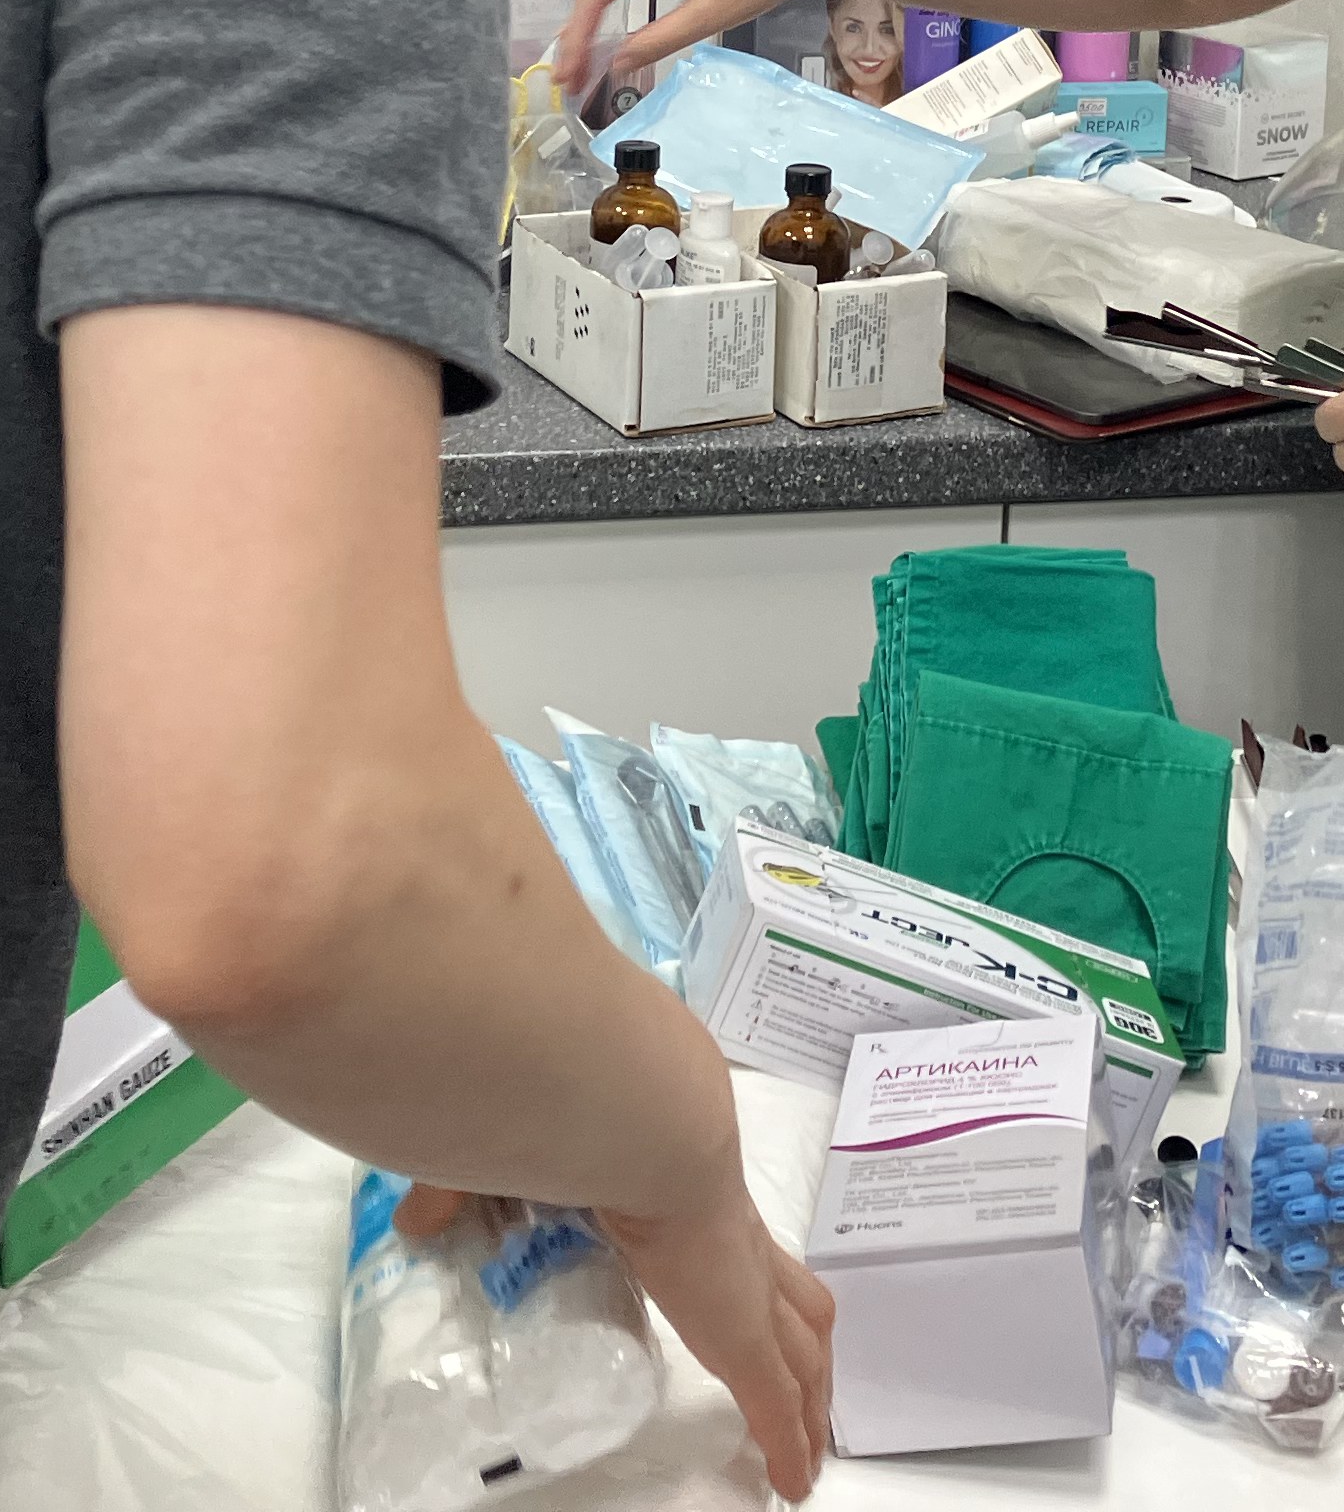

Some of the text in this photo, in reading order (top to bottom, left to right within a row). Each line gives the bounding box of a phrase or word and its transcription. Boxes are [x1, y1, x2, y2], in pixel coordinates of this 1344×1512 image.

[1086, 119, 1140, 133] REPAIR
[1256, 123, 1309, 146] SNOW
[120, 1048, 173, 1101] GAUZE
[875, 1055, 1039, 1082] АРТИКАИНА
